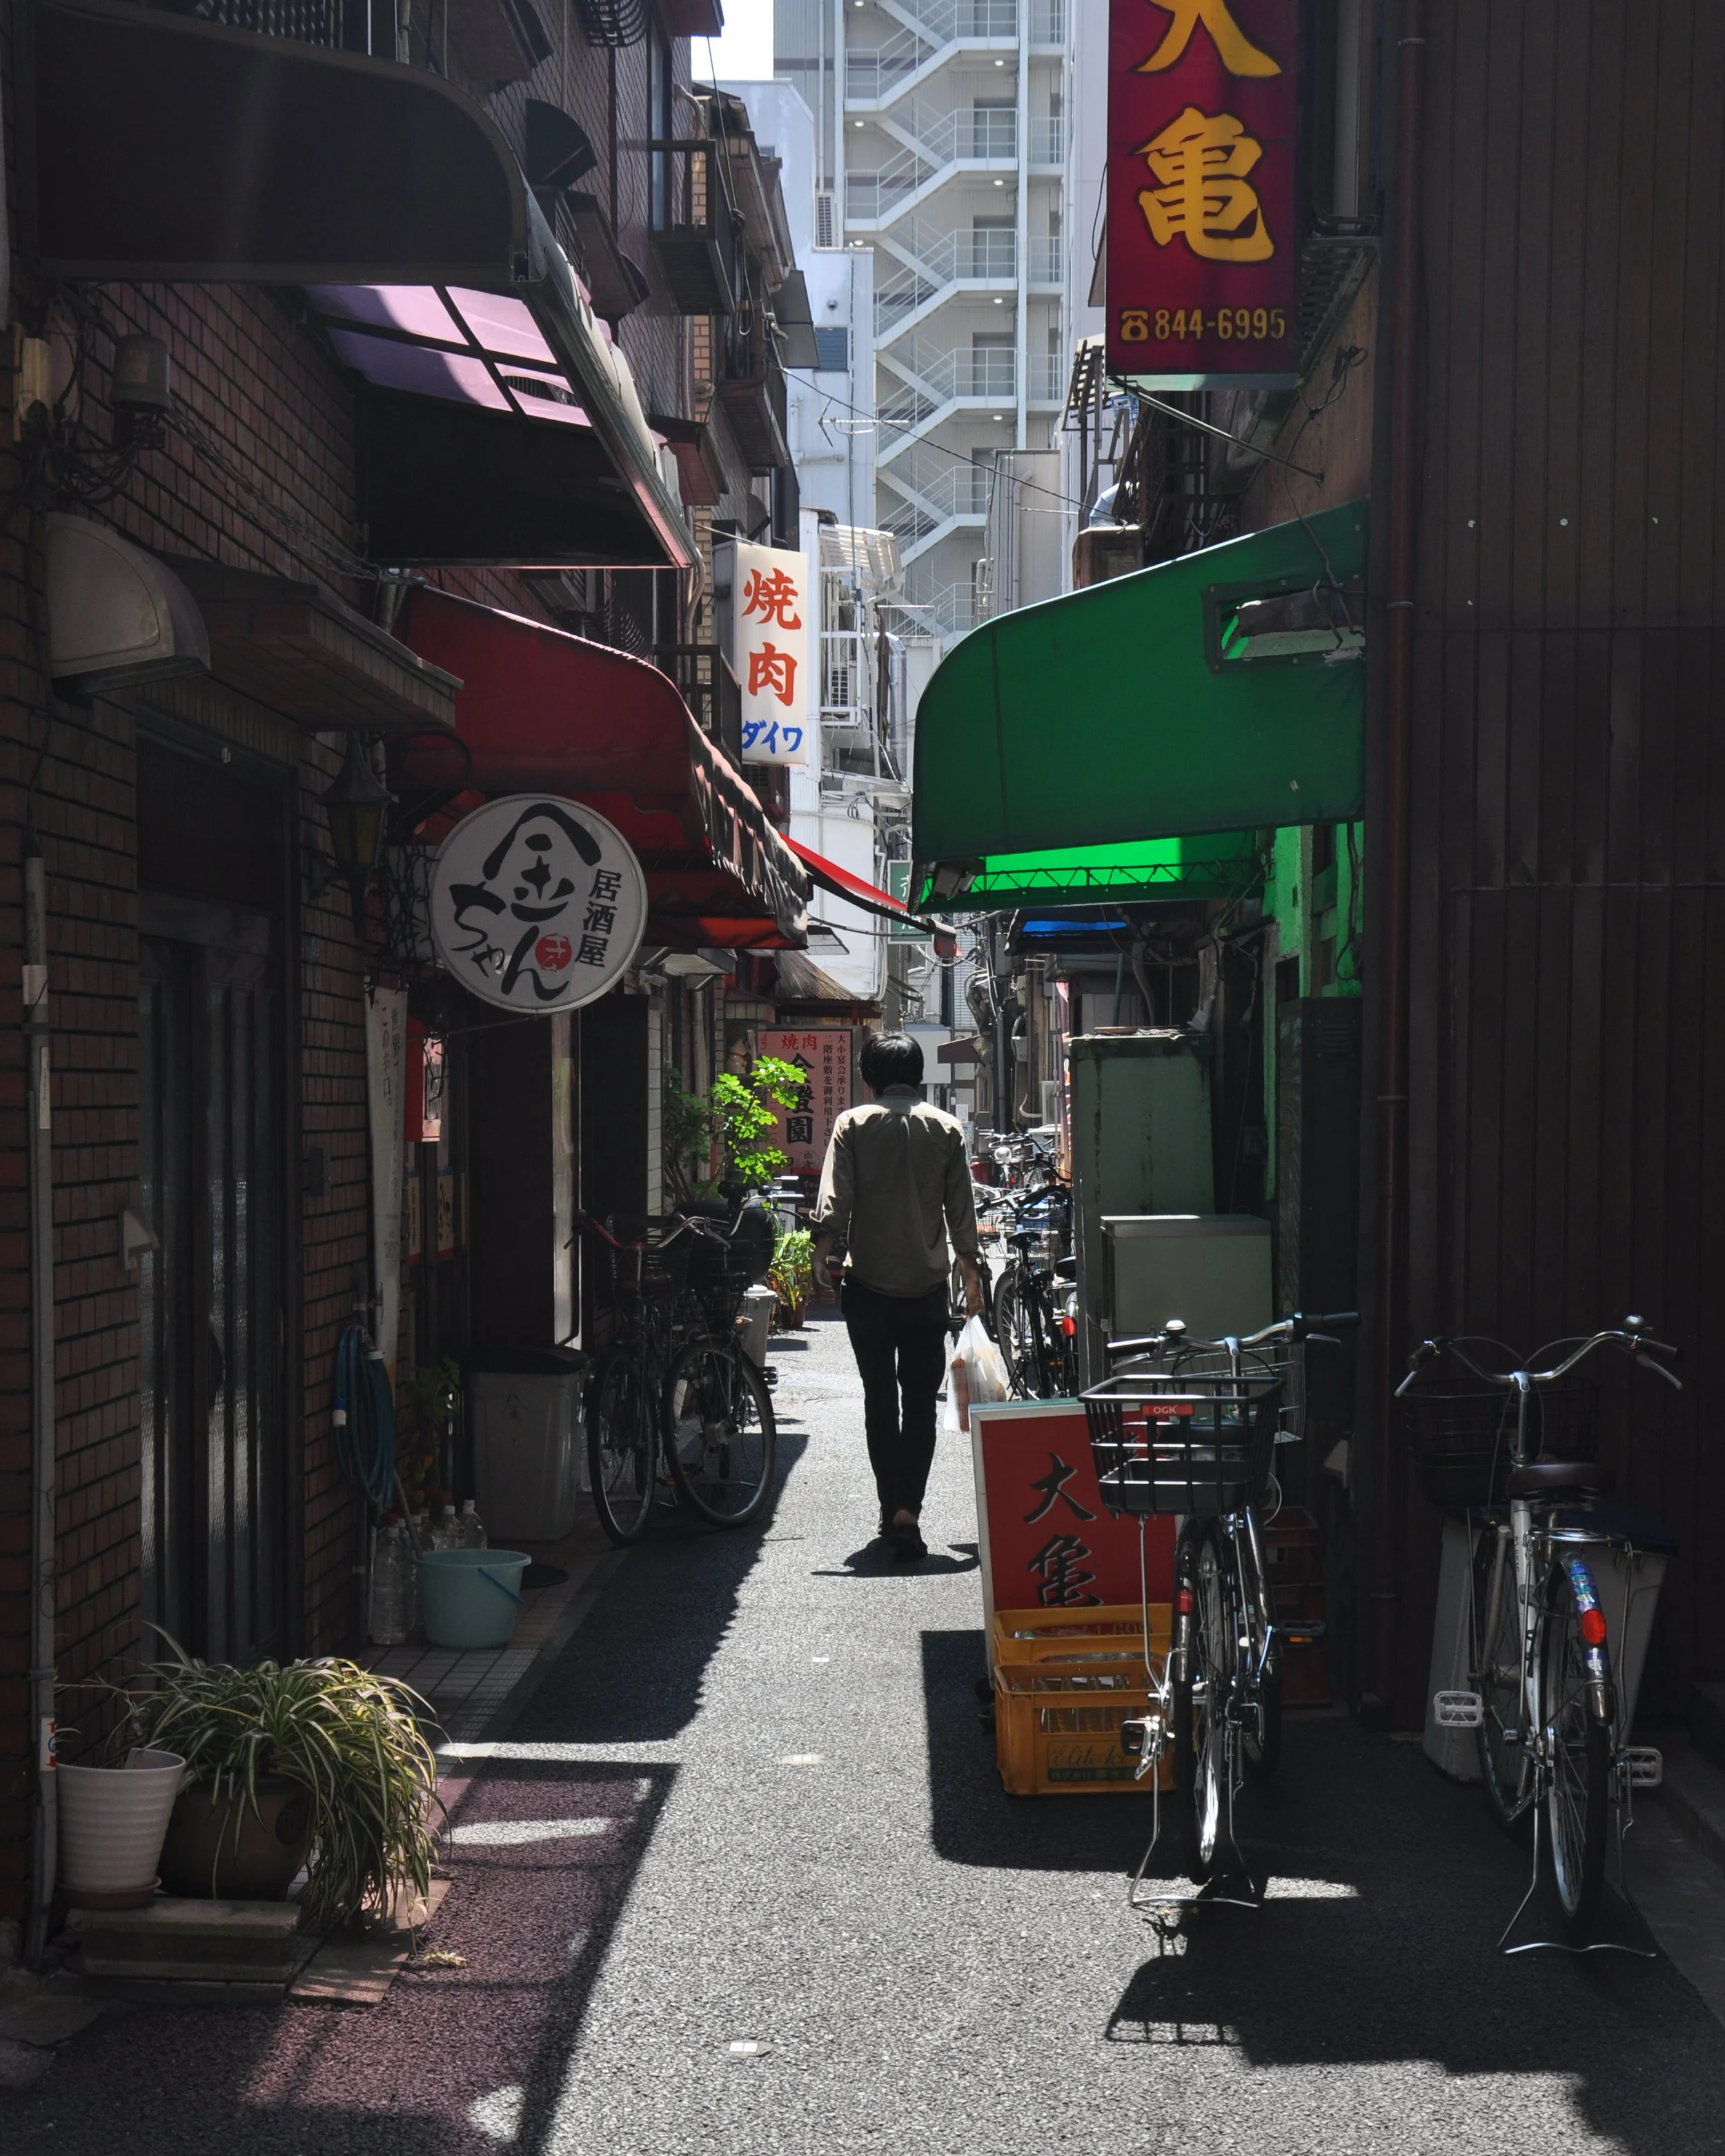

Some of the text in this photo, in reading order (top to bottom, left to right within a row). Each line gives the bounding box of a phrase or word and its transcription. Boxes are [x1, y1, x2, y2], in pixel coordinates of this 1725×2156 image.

[1154, 308, 1286, 340] 844-6995
[742, 568, 802, 706] 焼肉
[742, 720, 803, 754] ダイワ
[575, 869, 622, 968] 居酒屋
[782, 1034, 817, 1051] 焼肉
[1153, 1405, 1177, 1414] OGK
